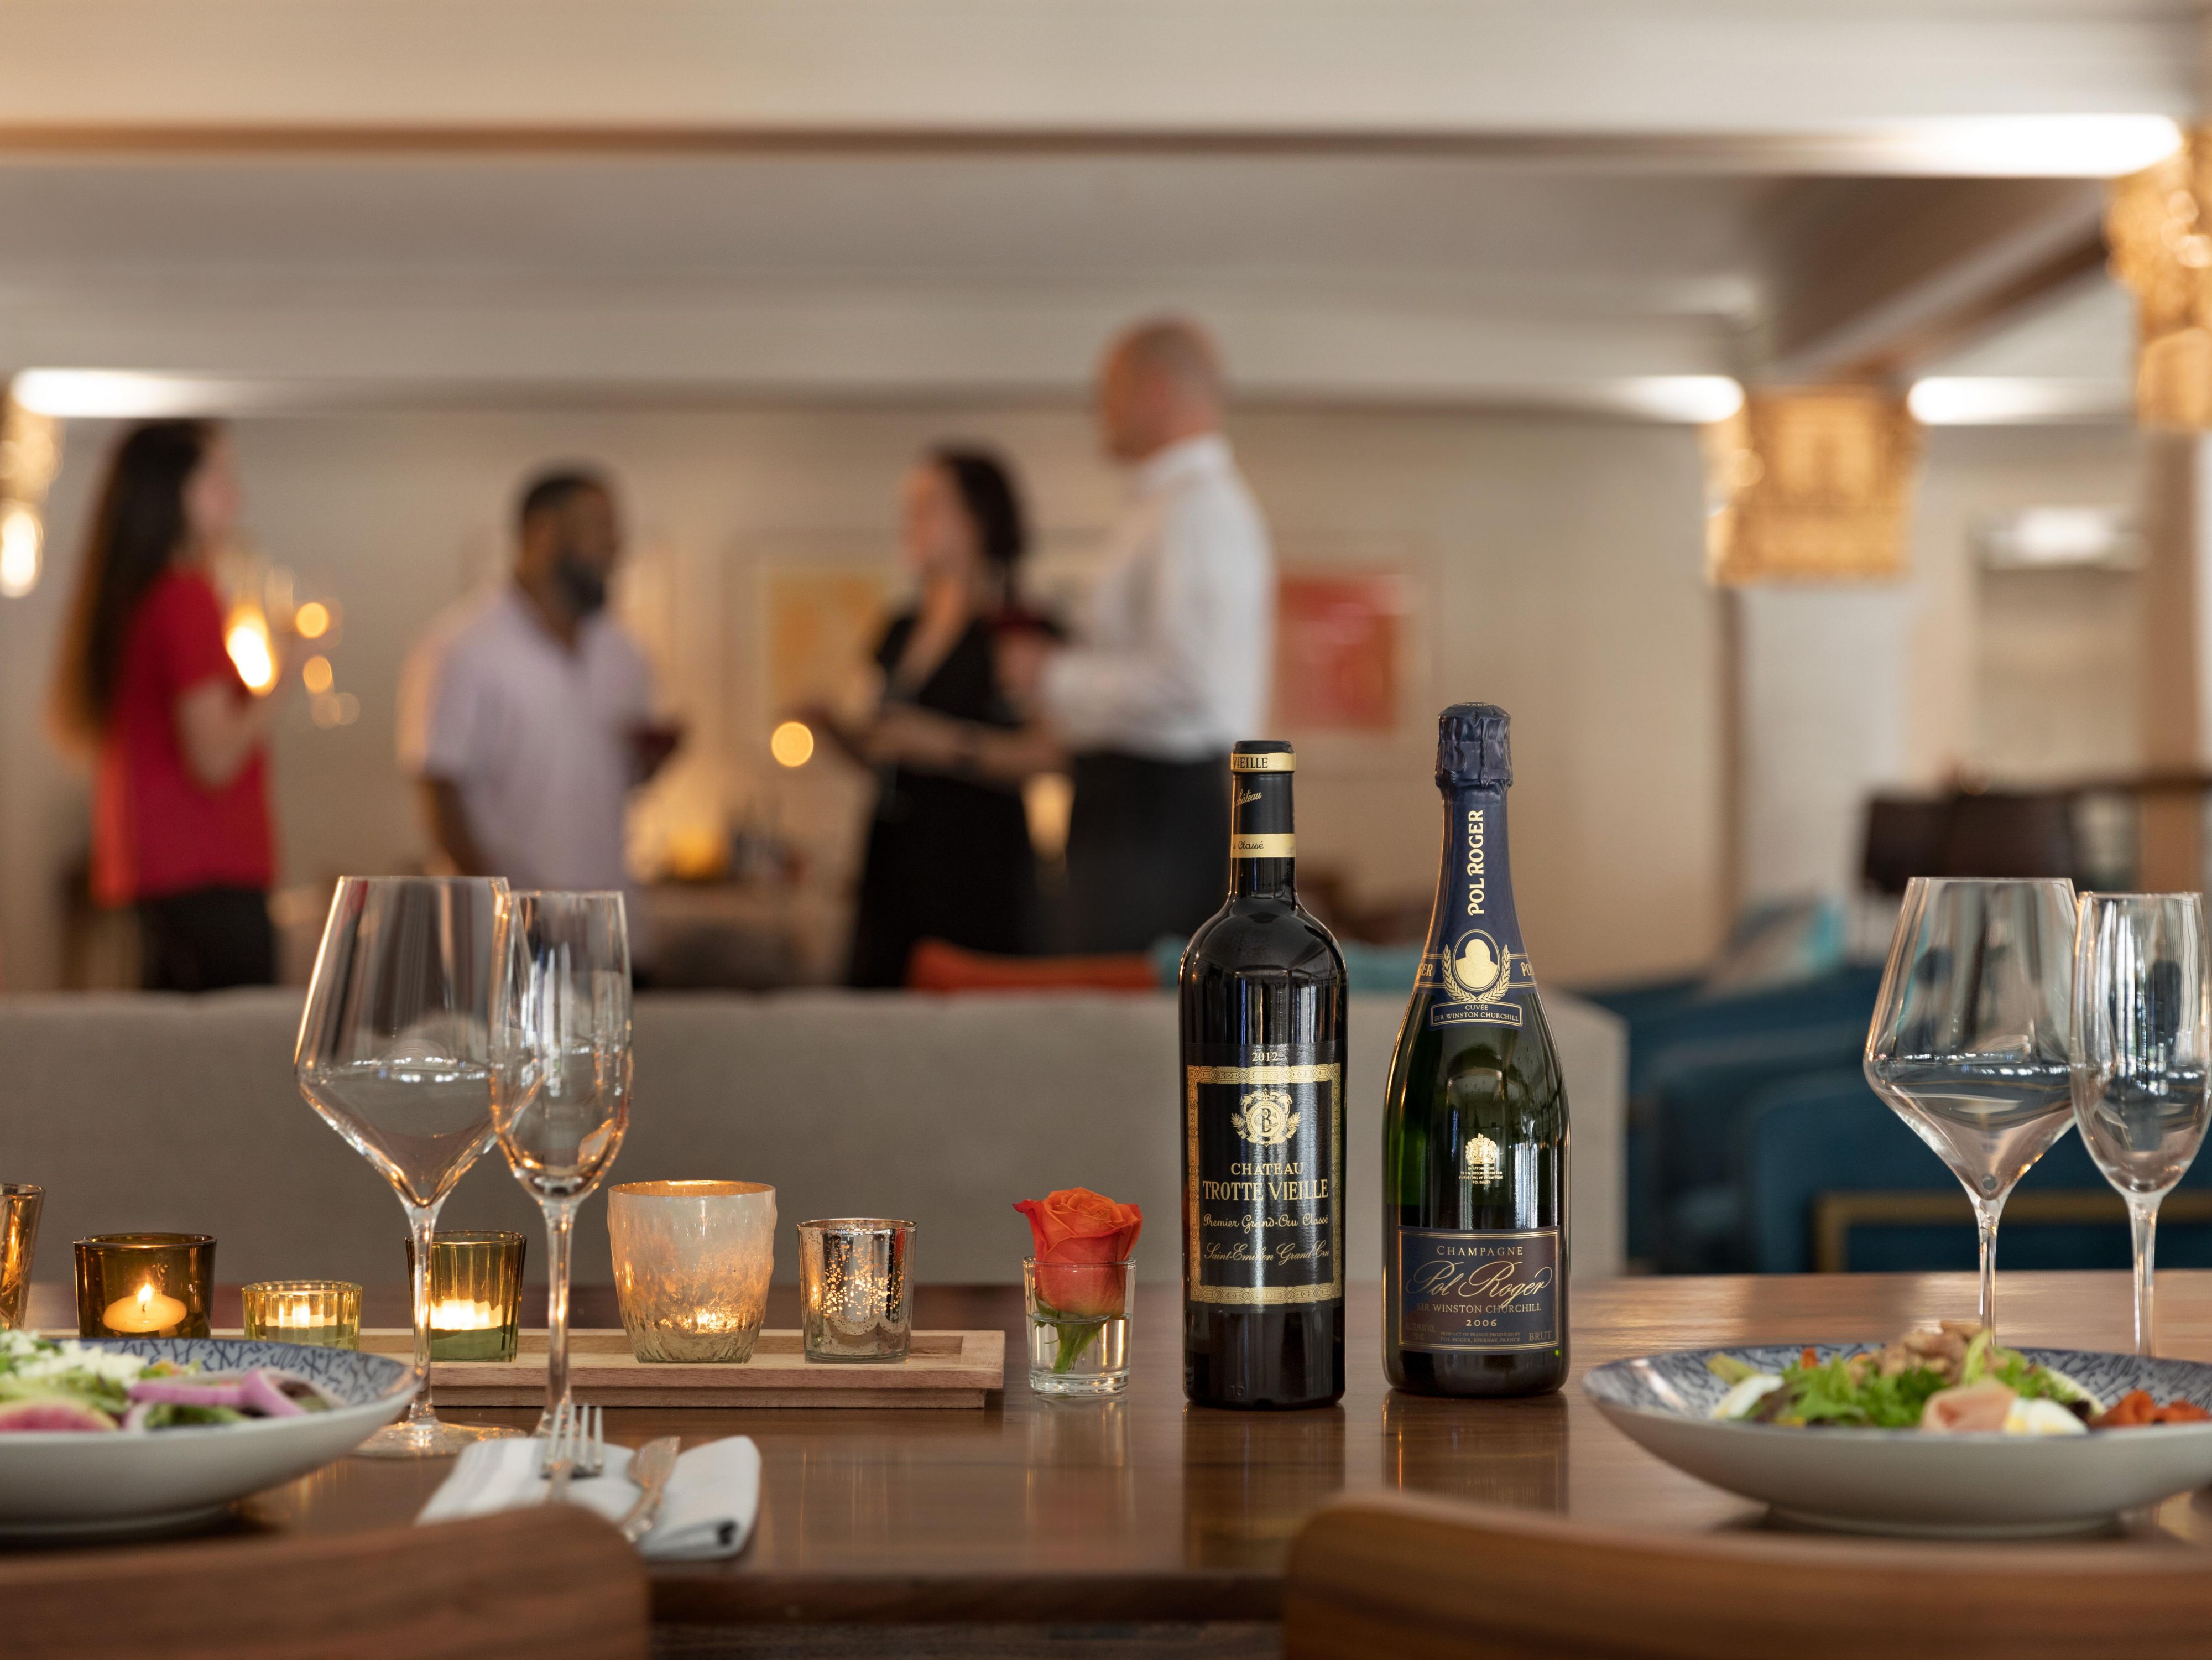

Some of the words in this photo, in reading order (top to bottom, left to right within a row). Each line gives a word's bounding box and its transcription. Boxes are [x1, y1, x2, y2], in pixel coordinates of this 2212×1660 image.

[1233, 757, 1268, 769] VIEILLE
[1236, 788, 1262, 807] château
[1238, 840, 1265, 850] Classé
[1467, 809, 1484, 876] ROGER
[1467, 877, 1485, 917] POL
[1480, 1012, 1519, 1022] CHURCHILL
[1251, 1052, 1278, 1062] 2012
[1230, 1162, 1305, 1176] CHATEAU
[1203, 1180, 1264, 1201] TROTTE
[1268, 1179, 1328, 1201] VIEILLE
[1203, 1213, 1240, 1227] Premier
[1302, 1213, 1328, 1226] Classé
[1276, 1241, 1321, 1266] Grand
[1315, 1240, 1330, 1258] Cru
[1437, 1246, 1524, 1256] CHAMPAGNE
[1406, 1260, 1464, 1296] Pol
[1458, 1261, 1552, 1309] Roger
[1417, 1303, 1431, 1312] SIR
[1432, 1304, 1482, 1313] WINSTON
[1486, 1303, 1542, 1314] CHURCHILL
[1465, 1319, 1498, 1327] 2006
[1528, 1331, 1552, 1341] BRUT
